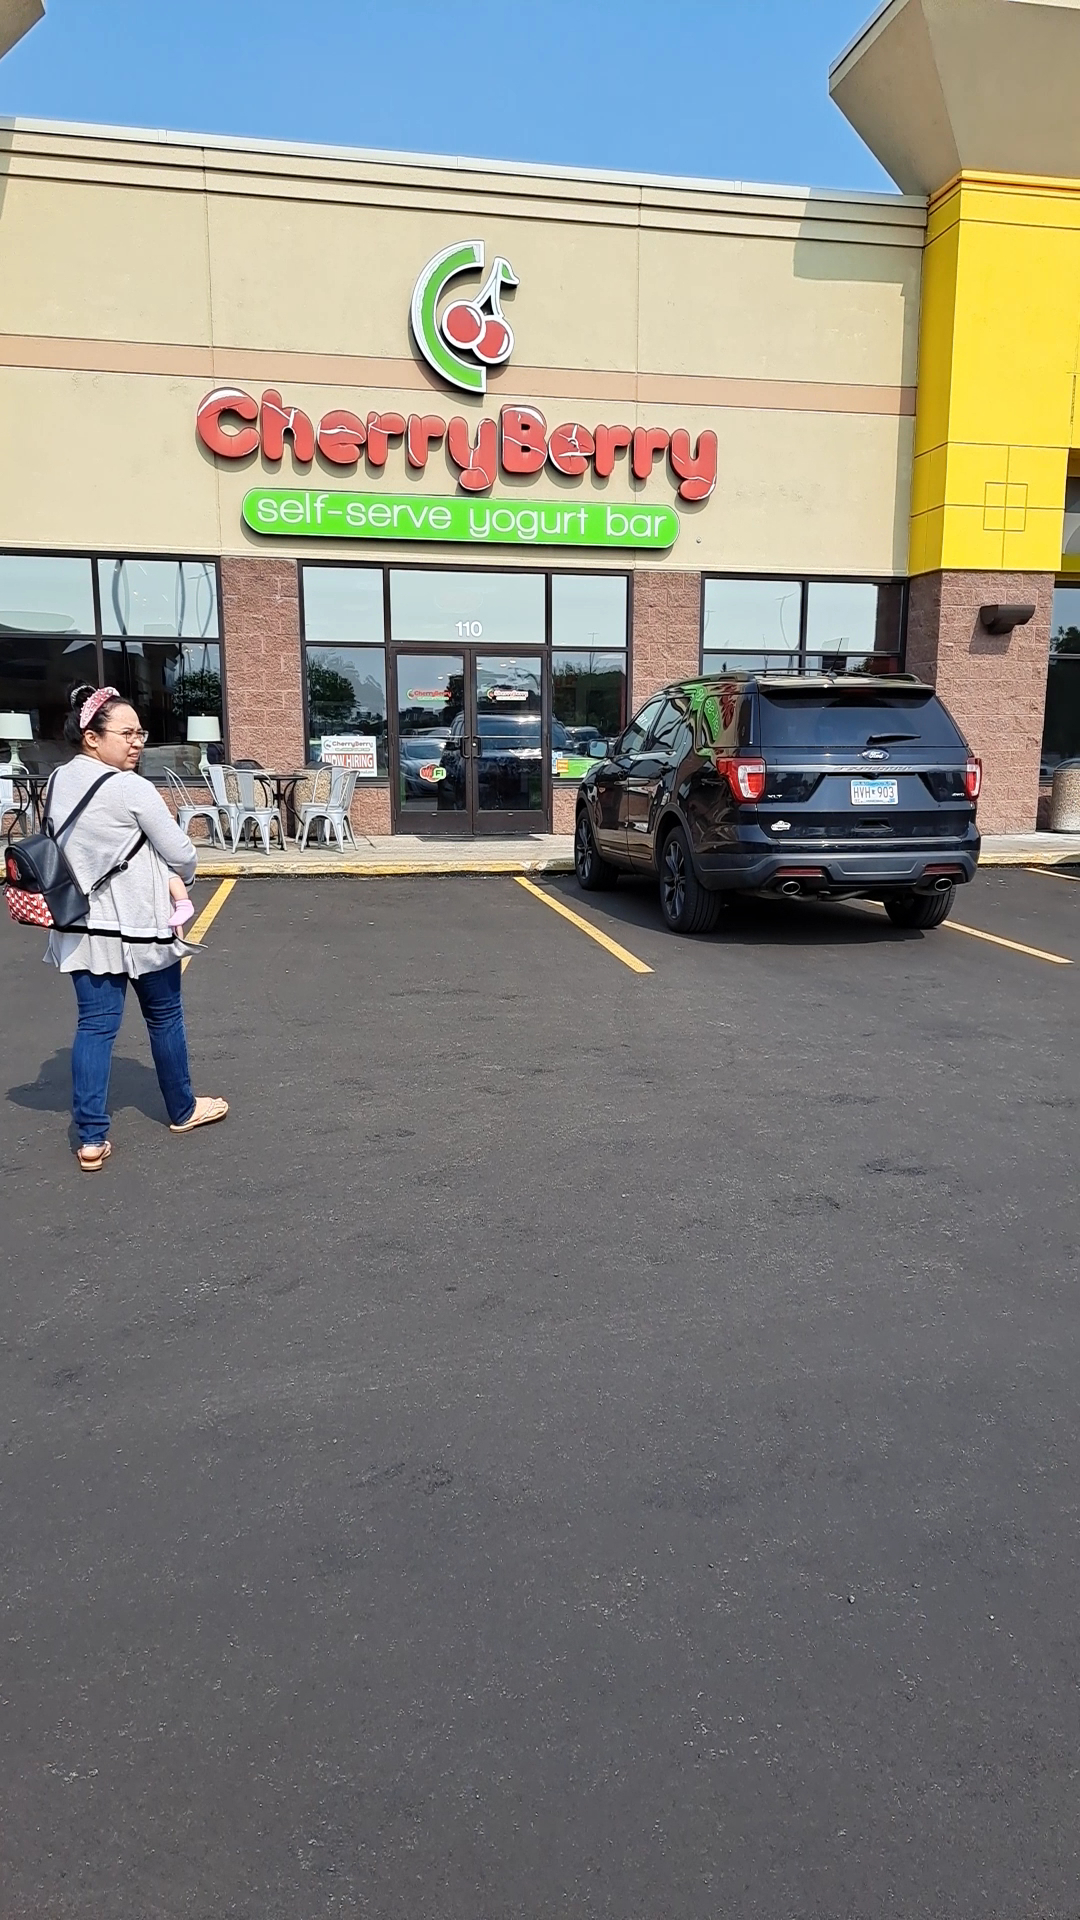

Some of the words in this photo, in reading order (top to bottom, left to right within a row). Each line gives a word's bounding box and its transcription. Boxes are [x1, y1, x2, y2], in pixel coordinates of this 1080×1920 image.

[197, 387, 718, 500] CherryBerry
[257, 492, 452, 529] self-serve
[469, 506, 589, 540] yogurt
[606, 505, 667, 538] bar
[455, 621, 483, 637] 110
[325, 754, 345, 767] NOW
[346, 754, 373, 768] HIRING
[868, 751, 884, 759] Ford
[853, 787, 871, 799] HVH
[877, 786, 895, 798] 903
